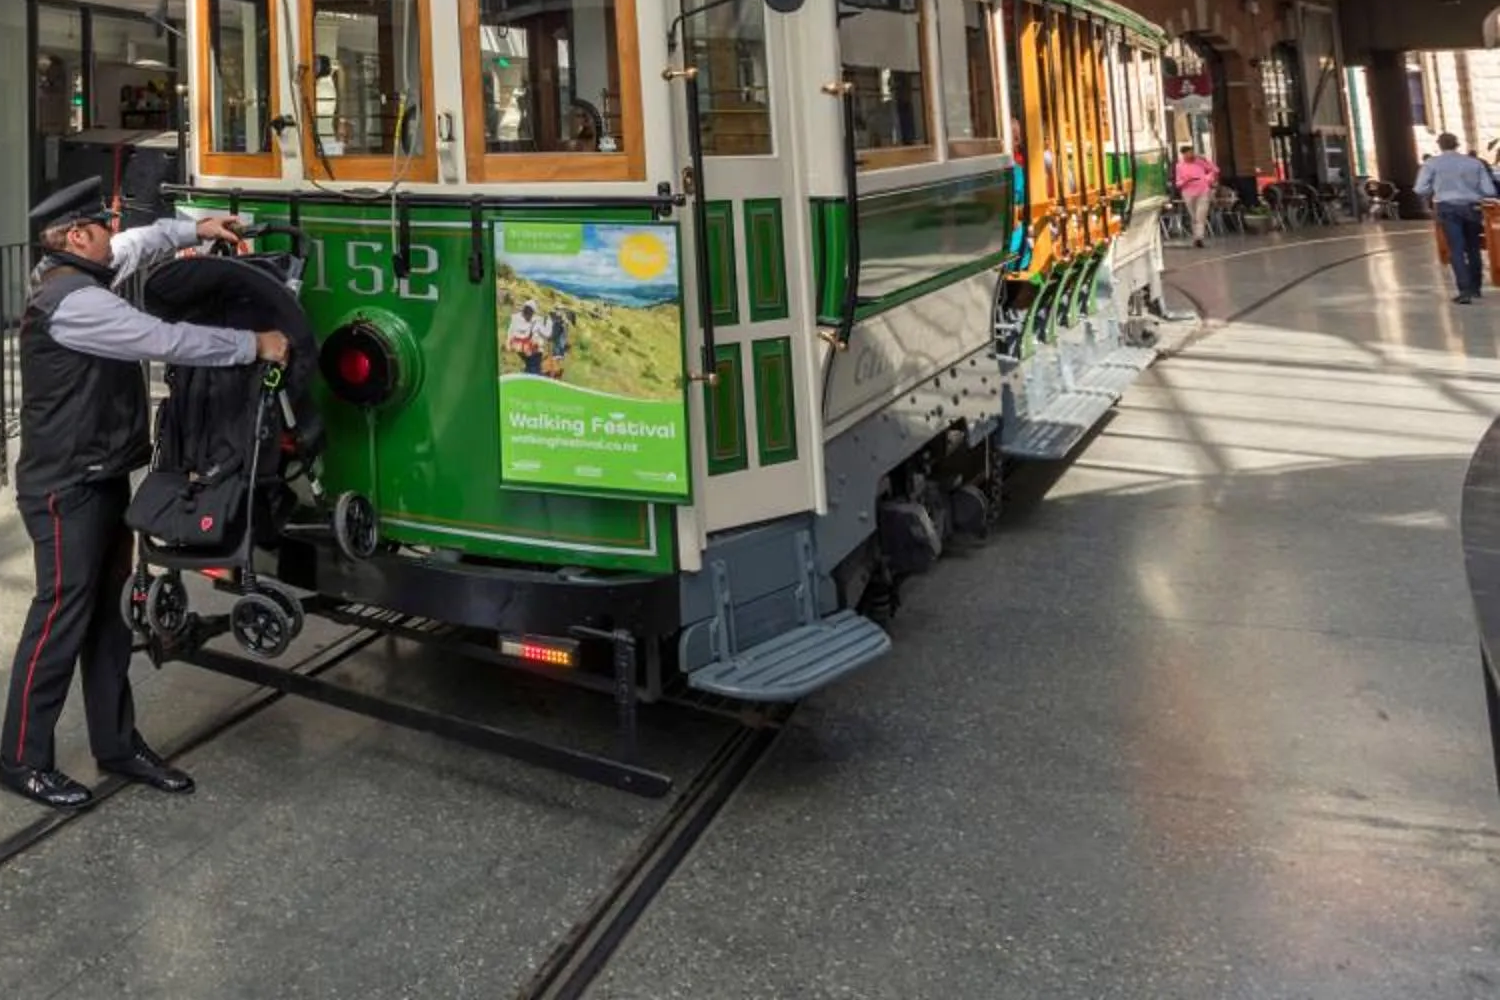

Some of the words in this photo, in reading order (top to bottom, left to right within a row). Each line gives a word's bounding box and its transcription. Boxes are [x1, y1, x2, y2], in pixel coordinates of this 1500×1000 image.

[310, 239, 440, 301] 152
[508, 411, 585, 437] Walking
[591, 415, 676, 440] Festival
